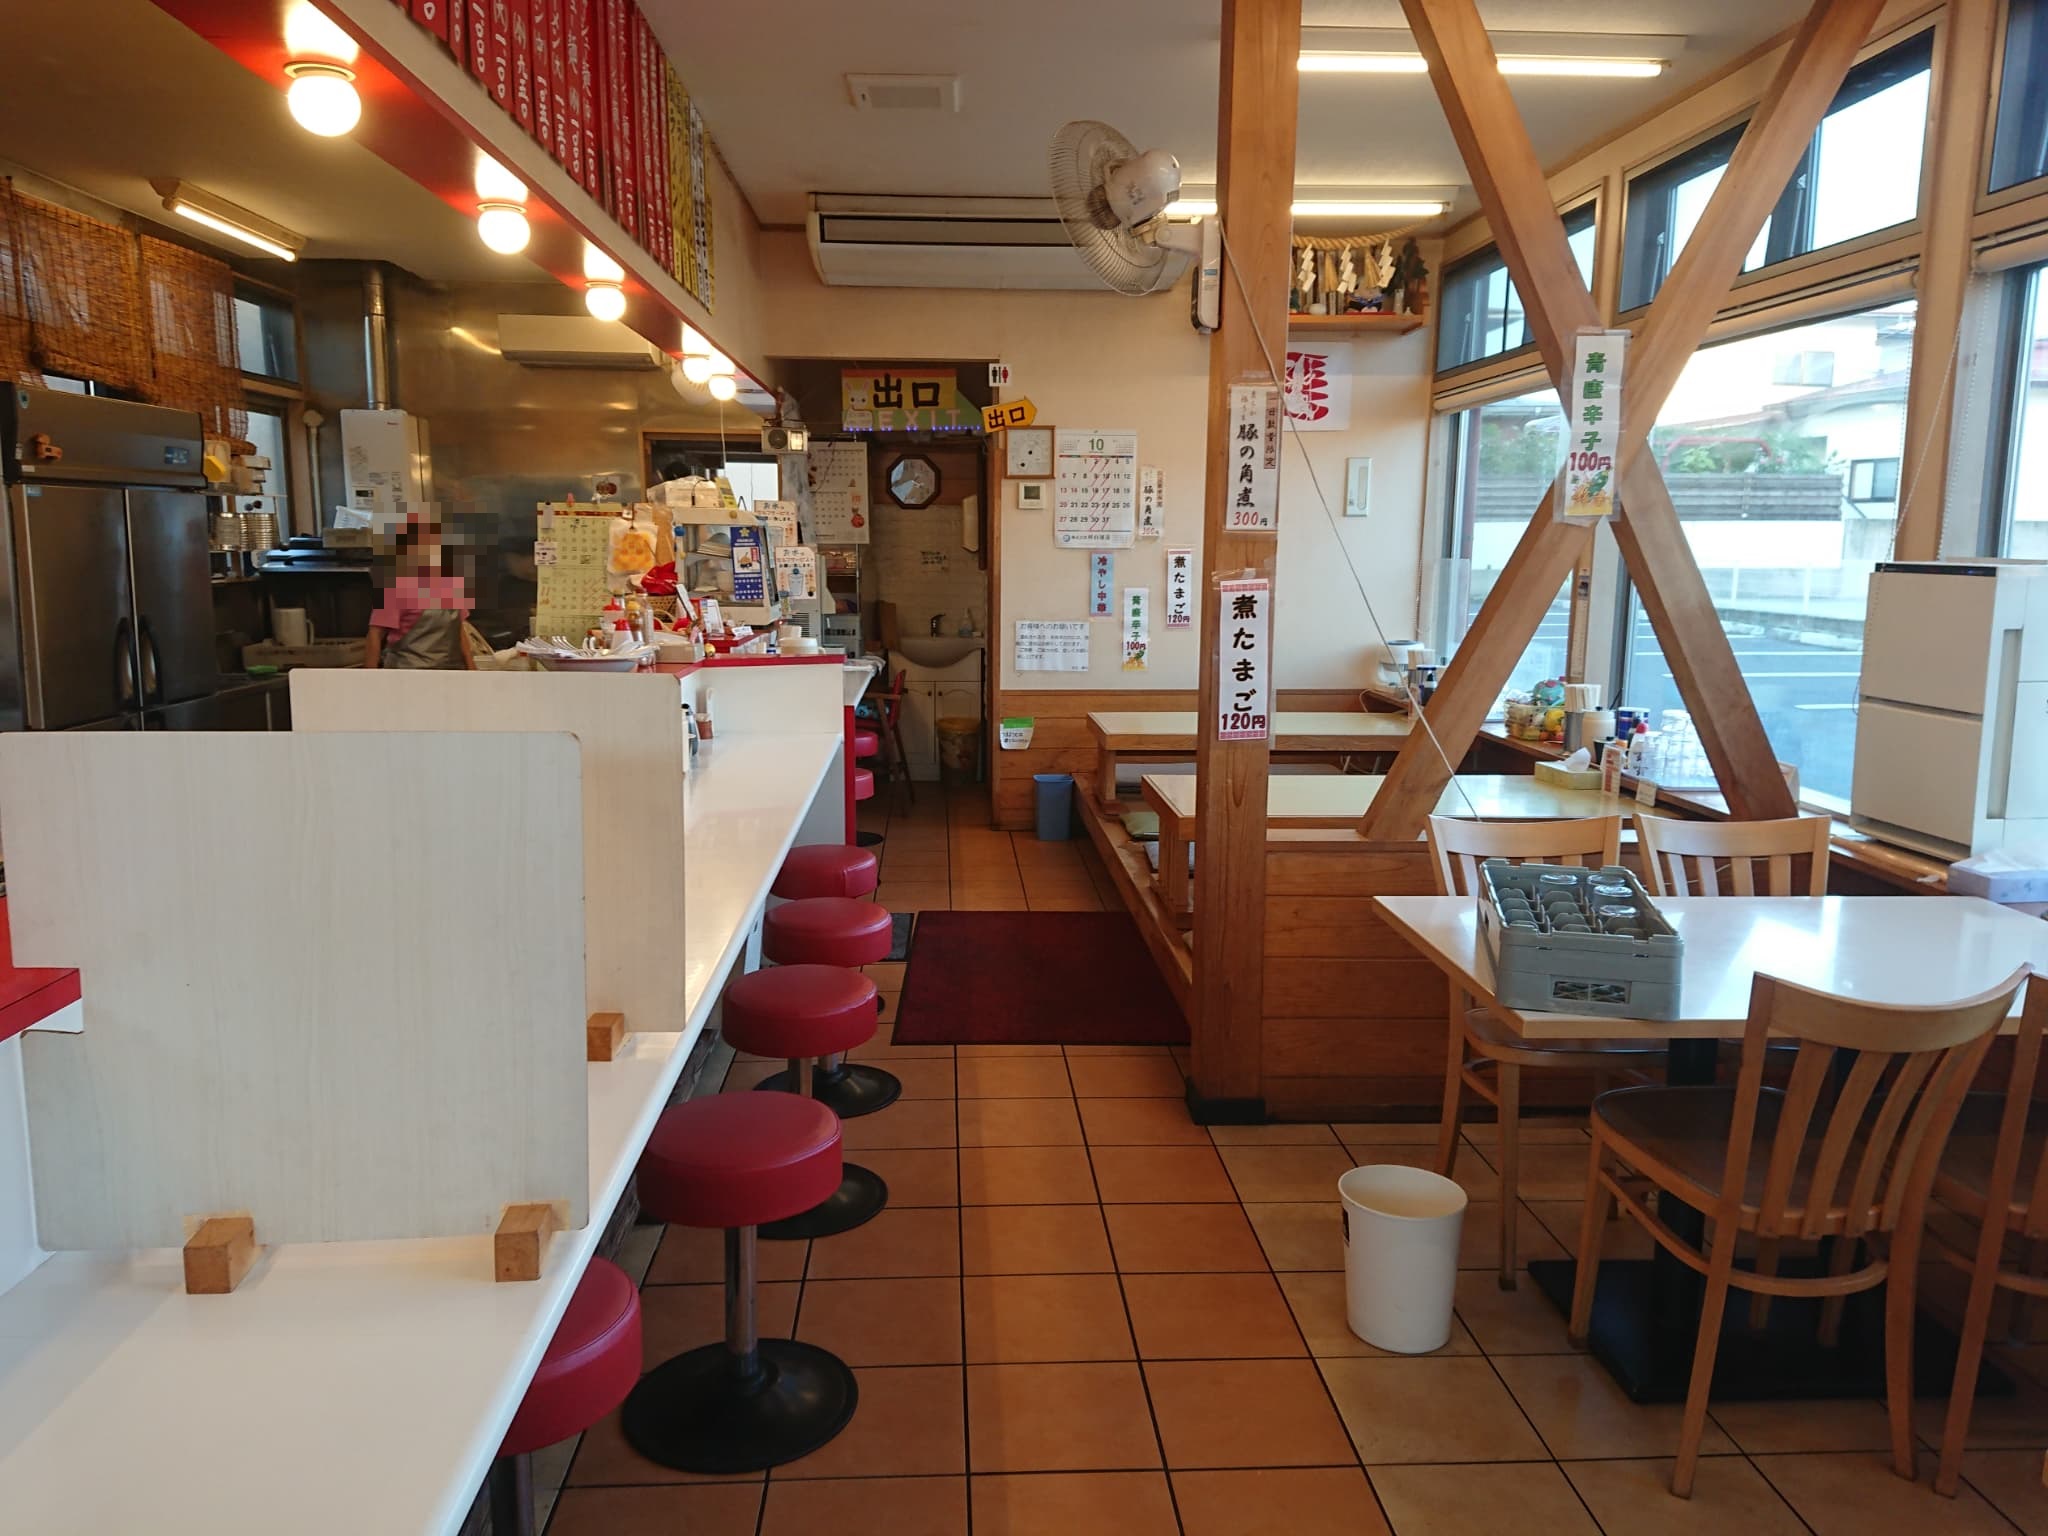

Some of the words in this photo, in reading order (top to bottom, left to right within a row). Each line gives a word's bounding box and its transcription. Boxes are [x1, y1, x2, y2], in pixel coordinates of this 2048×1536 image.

[873, 372, 940, 408] 出口
[1581, 351, 1607, 452] 青唐辛子
[878, 409, 960, 428] EXIT
[988, 406, 1026, 430] 出口
[1265, 395, 1277, 467] 一日数量限定
[1088, 438, 1104, 451] 10
[1237, 423, 1258, 508] 豚の角煮
[1569, 451, 1612, 471] 100円
[1233, 511, 1268, 527] 300円
[1173, 556, 1187, 614] 煮たまご
[1131, 595, 1142, 641] 青唐辛子
[1168, 614, 1190, 623] 120円
[1126, 641, 1146, 651] 100円
[1232, 594, 1257, 712] 煮たまご
[1221, 713, 1266, 730] 120円
